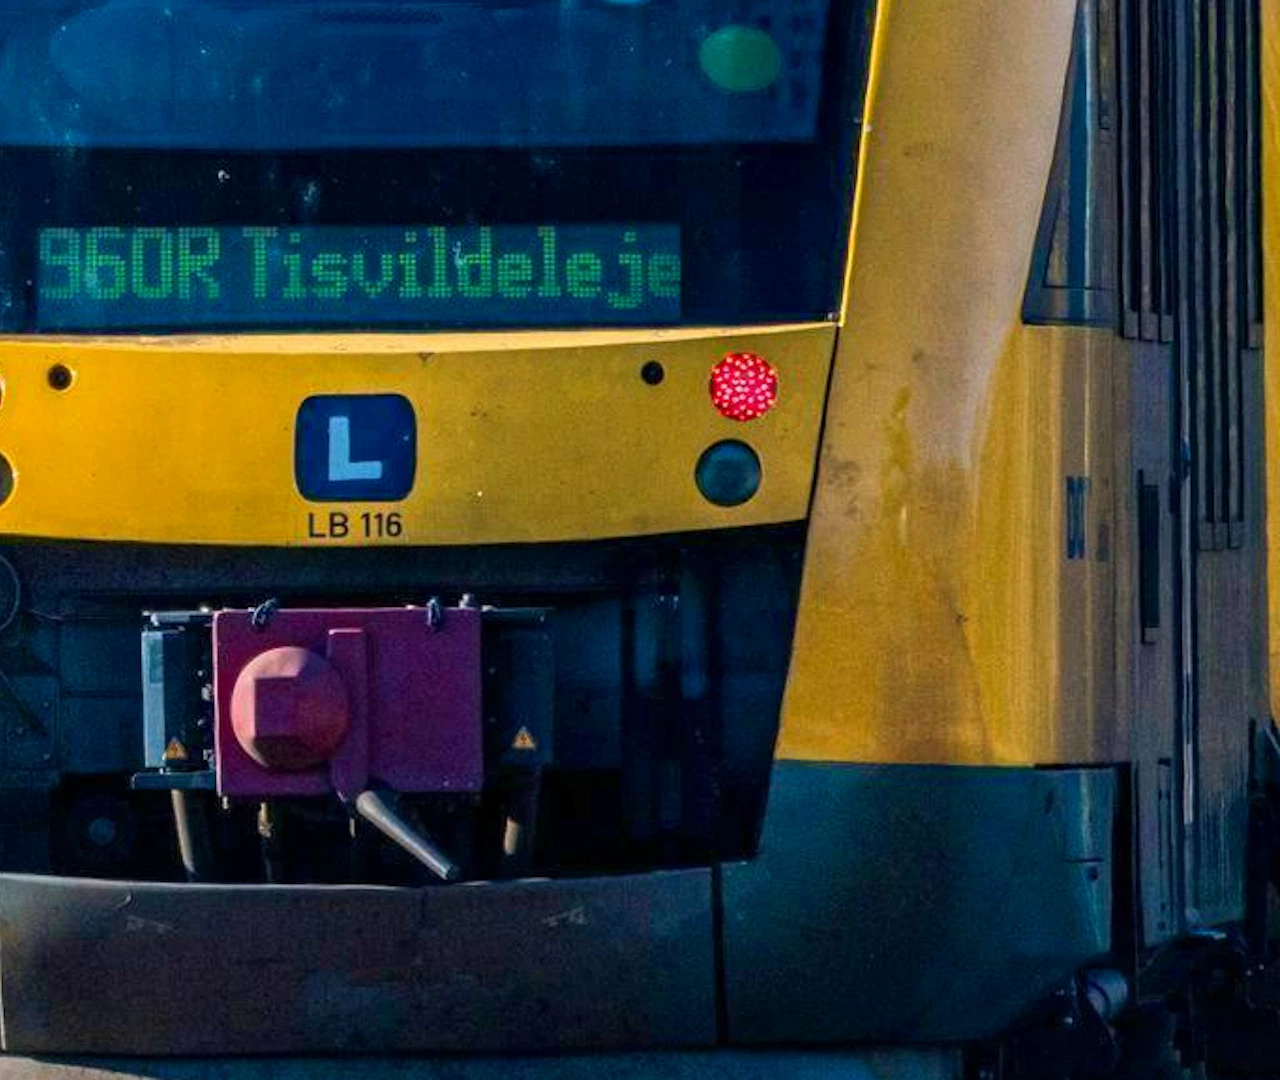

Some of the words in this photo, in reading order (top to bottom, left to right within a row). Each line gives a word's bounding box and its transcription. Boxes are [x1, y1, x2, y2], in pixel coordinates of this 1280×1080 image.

[39, 226, 220, 300] 960R
[242, 226, 681, 309] Tisvildeleje
[328, 415, 383, 481] L
[308, 512, 349, 538] LB
[360, 512, 402, 538] 116
